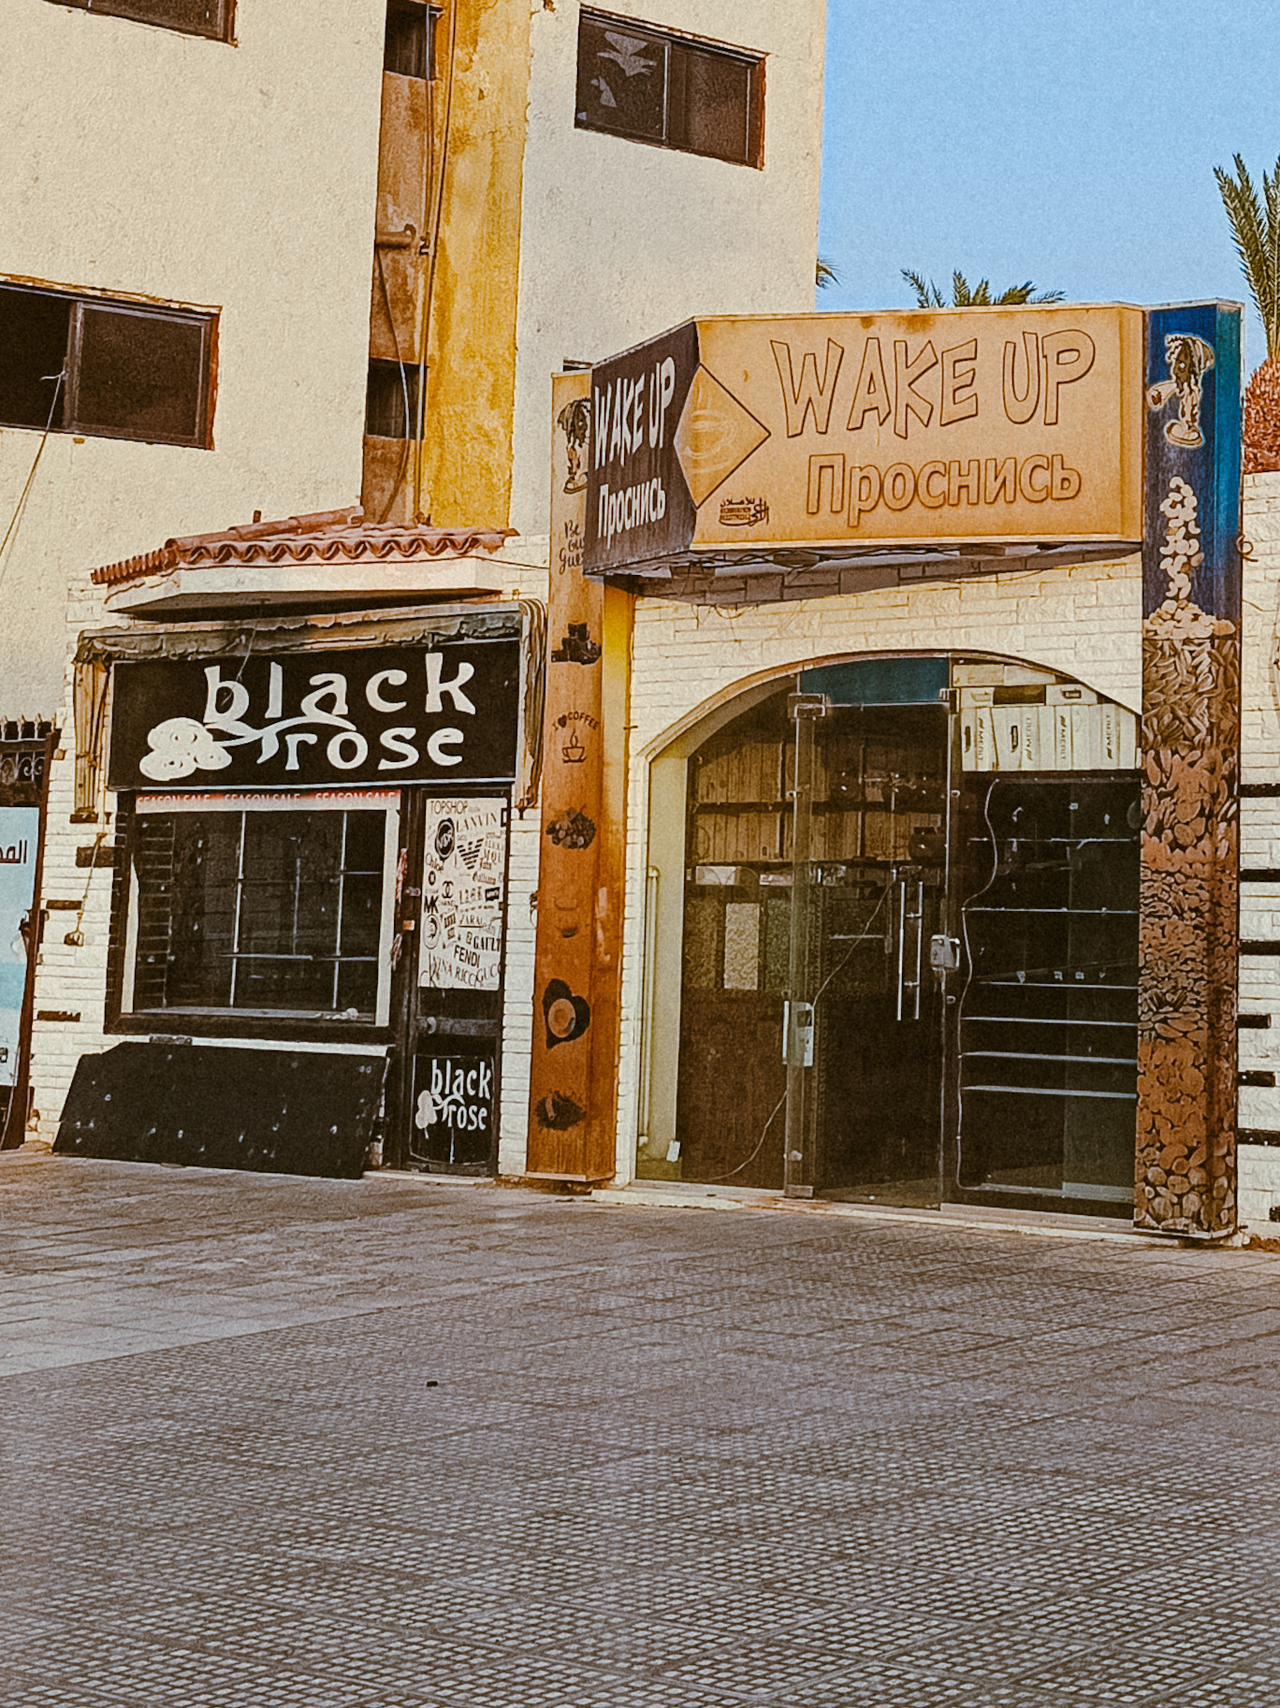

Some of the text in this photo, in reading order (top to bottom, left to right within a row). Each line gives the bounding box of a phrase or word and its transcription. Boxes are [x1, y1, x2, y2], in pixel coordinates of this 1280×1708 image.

[770, 329, 1095, 439] WAKE UP
[594, 356, 675, 471] WAKE UP
[806, 453, 1081, 528] Проснись
[598, 477, 666, 550] Проснись
[203, 652, 476, 724] black
[567, 711, 600, 730] COFFEE
[285, 726, 464, 771] rose
[430, 800, 468, 814] TOPSHOP
[424, 895, 439, 913] MK
[453, 944, 480, 968] FENDI
[431, 1059, 491, 1100] black
[448, 1104, 488, 1130] rose
